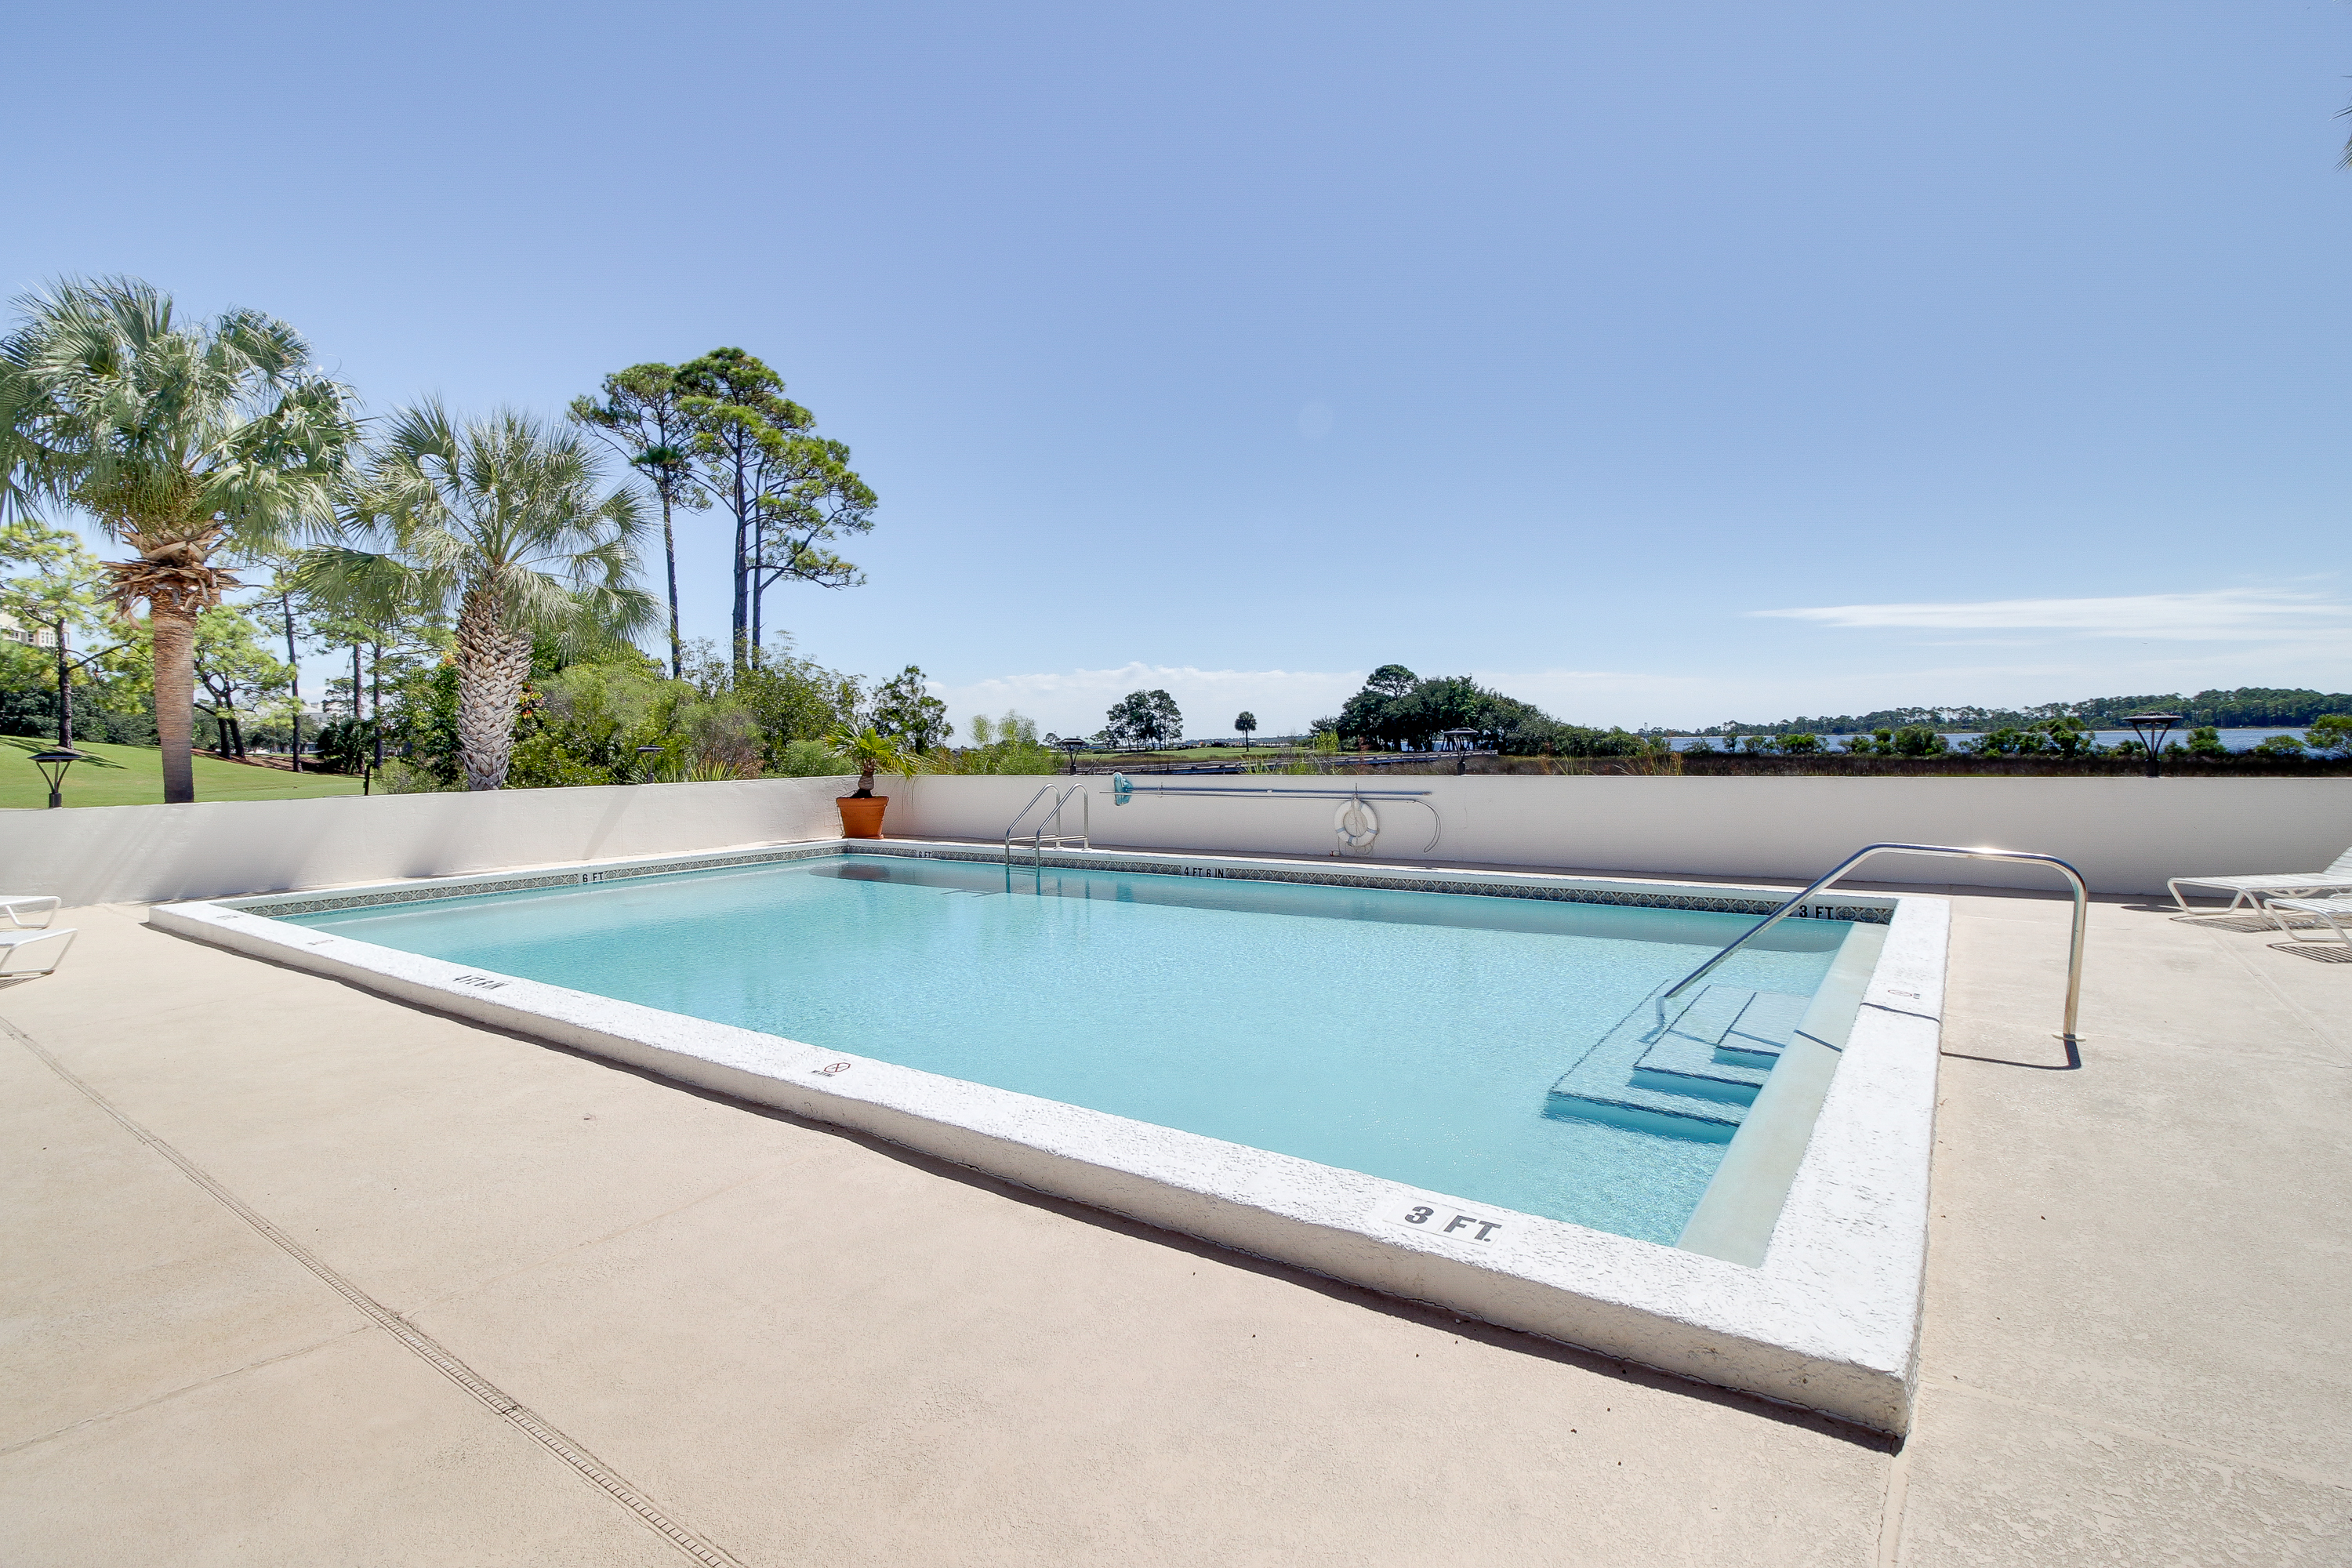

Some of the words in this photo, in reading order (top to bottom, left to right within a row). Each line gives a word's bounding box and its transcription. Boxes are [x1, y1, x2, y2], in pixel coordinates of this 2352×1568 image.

[583, 873, 588, 882] 6
[593, 872, 604, 881] FT
[1184, 867, 1189, 876] 4
[1192, 867, 1202, 877] FT
[1207, 869, 1211, 877] 6
[1215, 869, 1224, 878] IN
[1799, 905, 1808, 917] 3
[1404, 1206, 1434, 1224] 3
[1443, 1214, 1502, 1242] FT.
